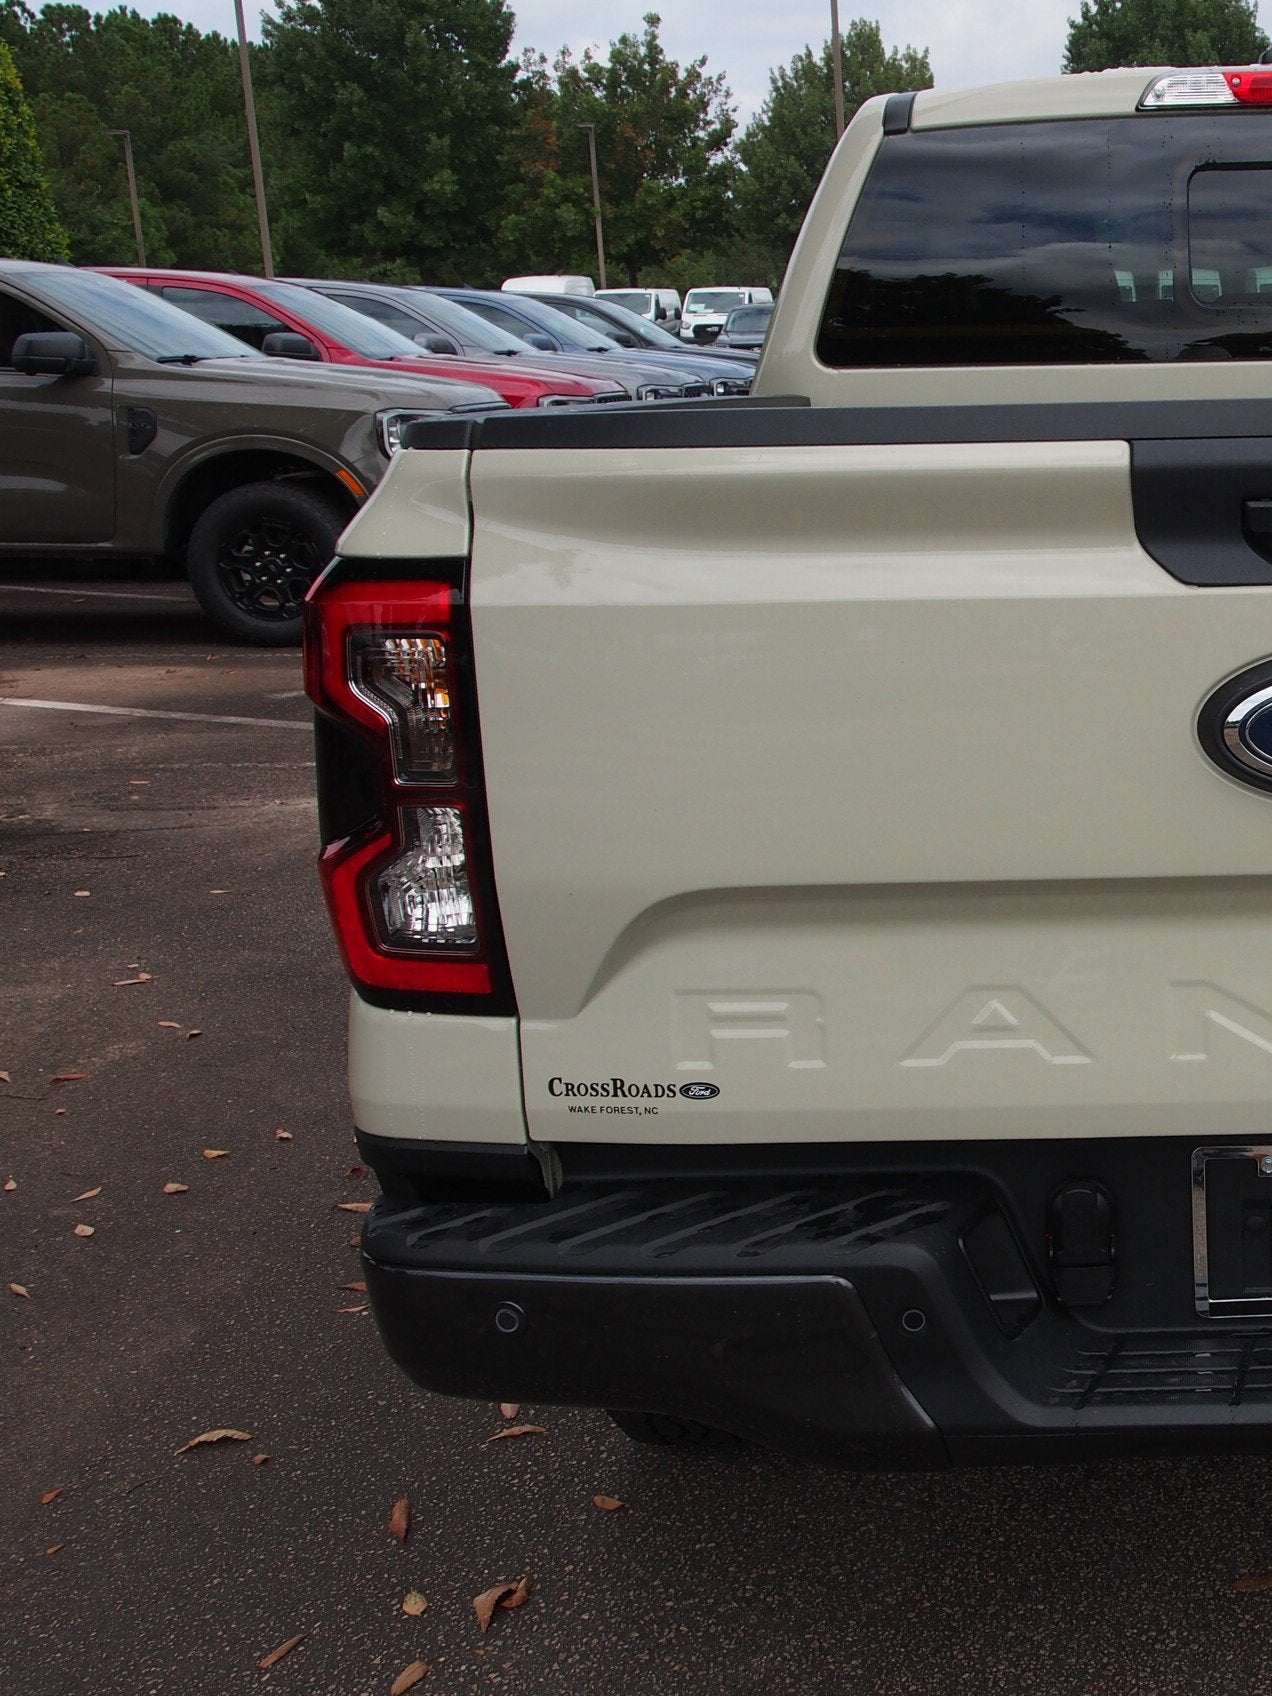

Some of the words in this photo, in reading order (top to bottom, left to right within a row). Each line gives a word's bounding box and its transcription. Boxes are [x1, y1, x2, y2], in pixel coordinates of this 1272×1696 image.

[688, 1085, 712, 1097] Ford
[567, 1105, 598, 1115] WAKE
[600, 1105, 642, 1116] FOREST,
[644, 1106, 659, 1115] NC
